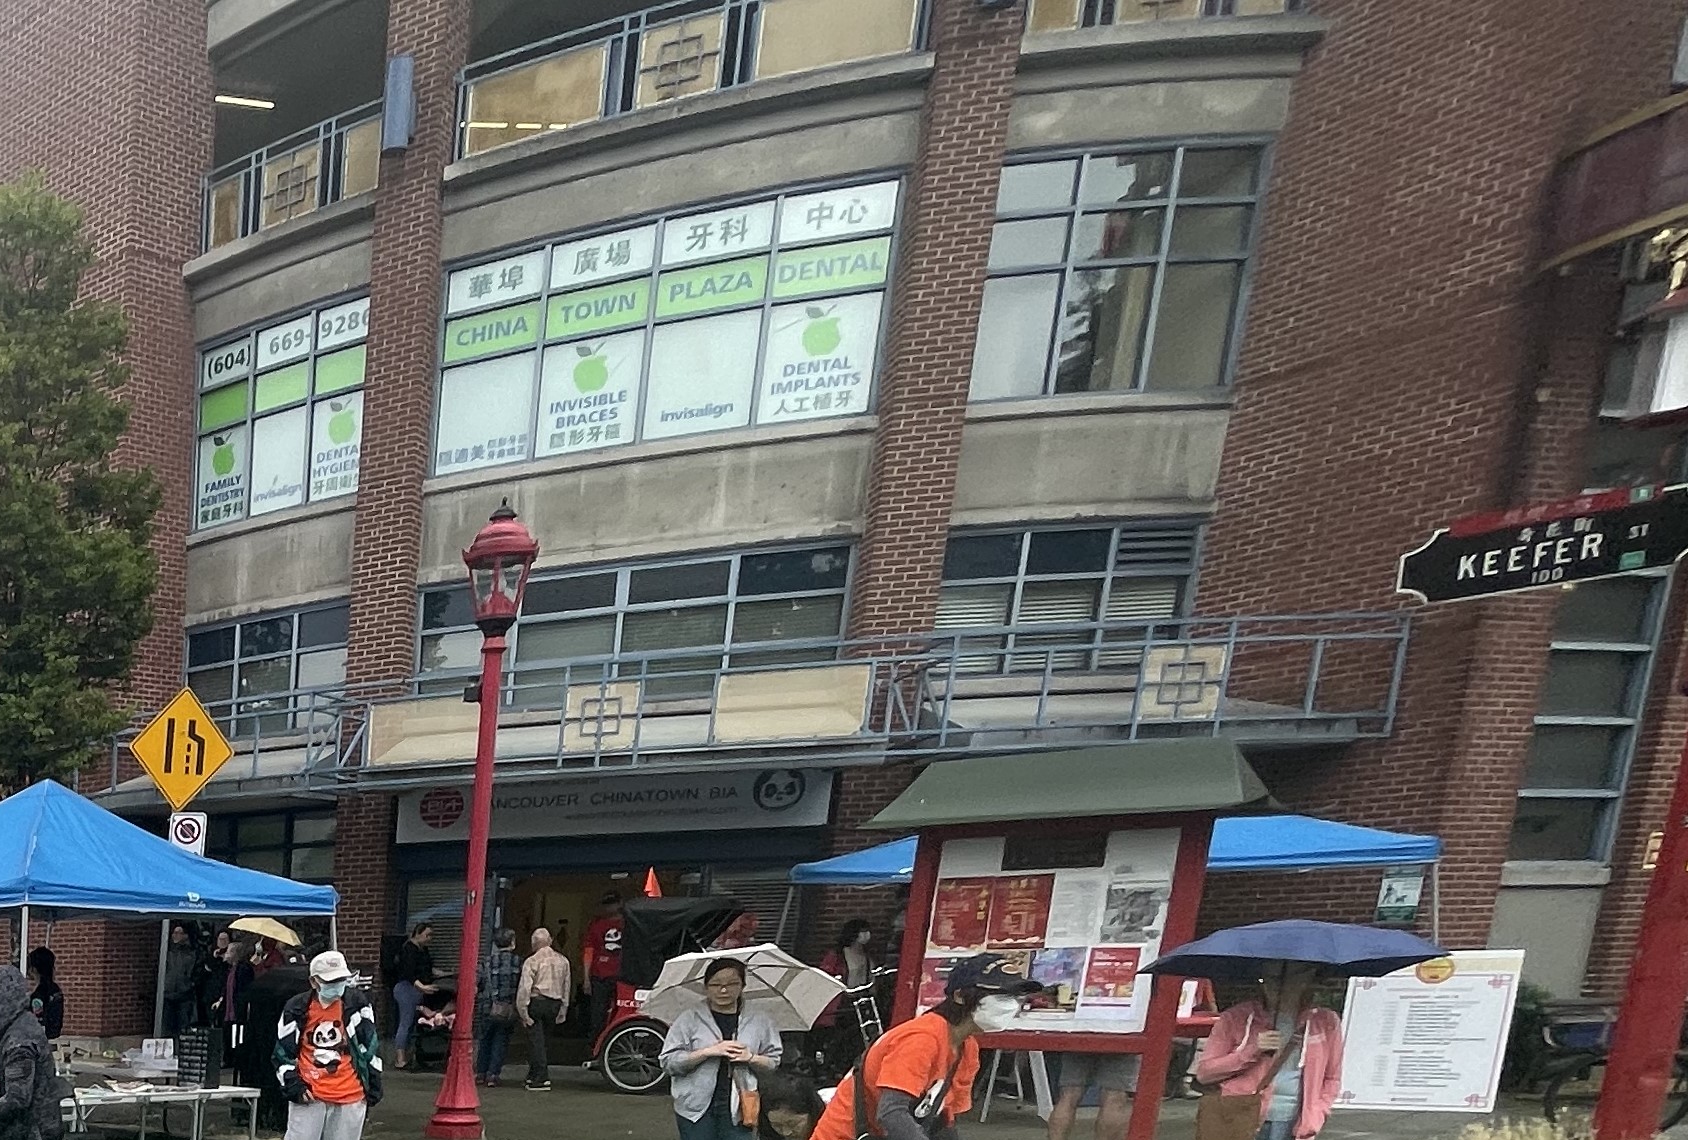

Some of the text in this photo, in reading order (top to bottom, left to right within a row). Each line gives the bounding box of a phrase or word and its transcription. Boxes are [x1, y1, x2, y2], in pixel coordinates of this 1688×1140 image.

[469, 199, 869, 299] 華埠 廣場 牙科 中心
[456, 251, 883, 346] CHINA TOWN PLAZA DENTAL
[207, 344, 251, 380] (604)
[783, 356, 852, 378] DENTAL
[770, 371, 861, 396] IMPLANTS
[549, 389, 628, 415] INVISIBLE
[660, 402, 735, 423] invisalign
[555, 407, 619, 430] BRACES
[316, 443, 359, 465] DENTA
[204, 473, 243, 494] FAMILY
[253, 482, 303, 503] invisalign
[200, 487, 245, 509] DENTISTRY
[1456, 532, 1604, 581] KEEFER
[1626, 523, 1650, 540] ST
[590, 787, 700, 806] CHINATOWN
[709, 786, 739, 800] BIA
